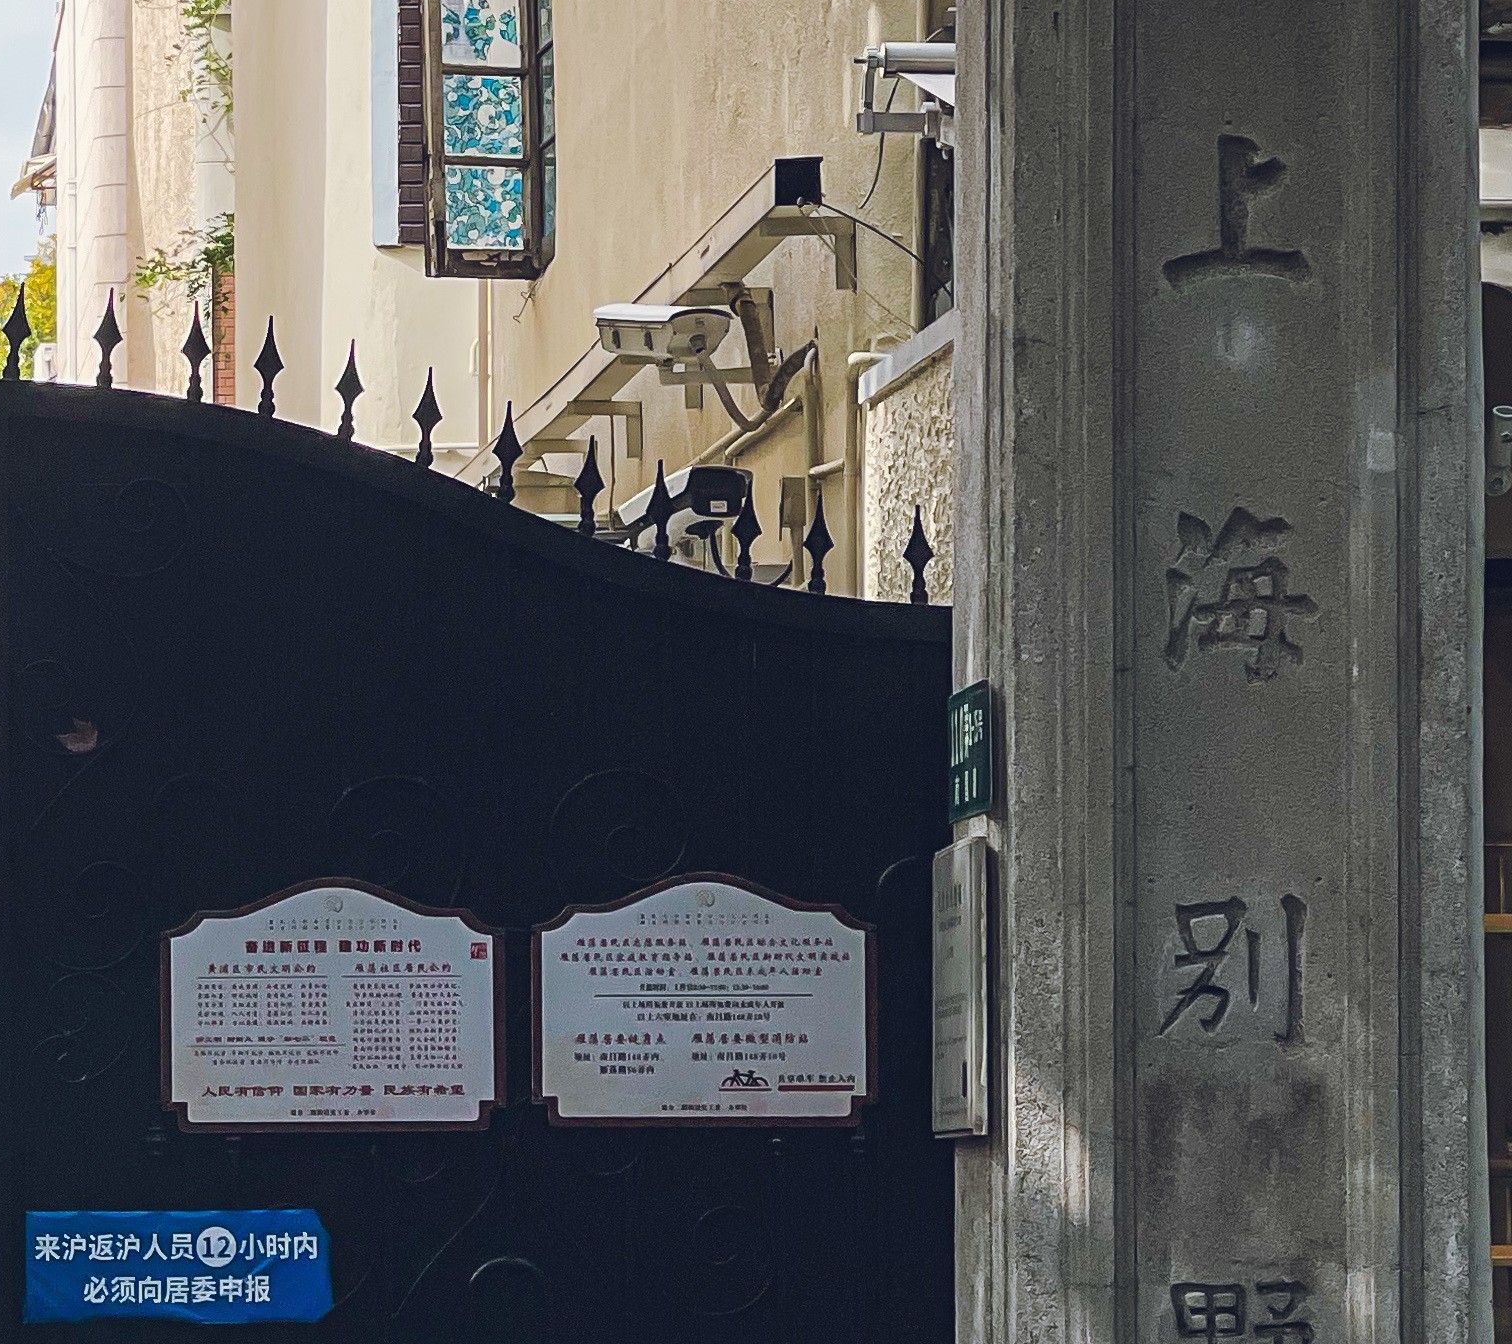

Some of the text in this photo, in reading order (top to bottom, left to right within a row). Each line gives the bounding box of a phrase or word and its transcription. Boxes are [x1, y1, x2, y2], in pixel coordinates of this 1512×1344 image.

[35, 1231, 318, 1262] 来沪返沪人员12小时内
[83, 1275, 271, 1304] 必须向居委申报
